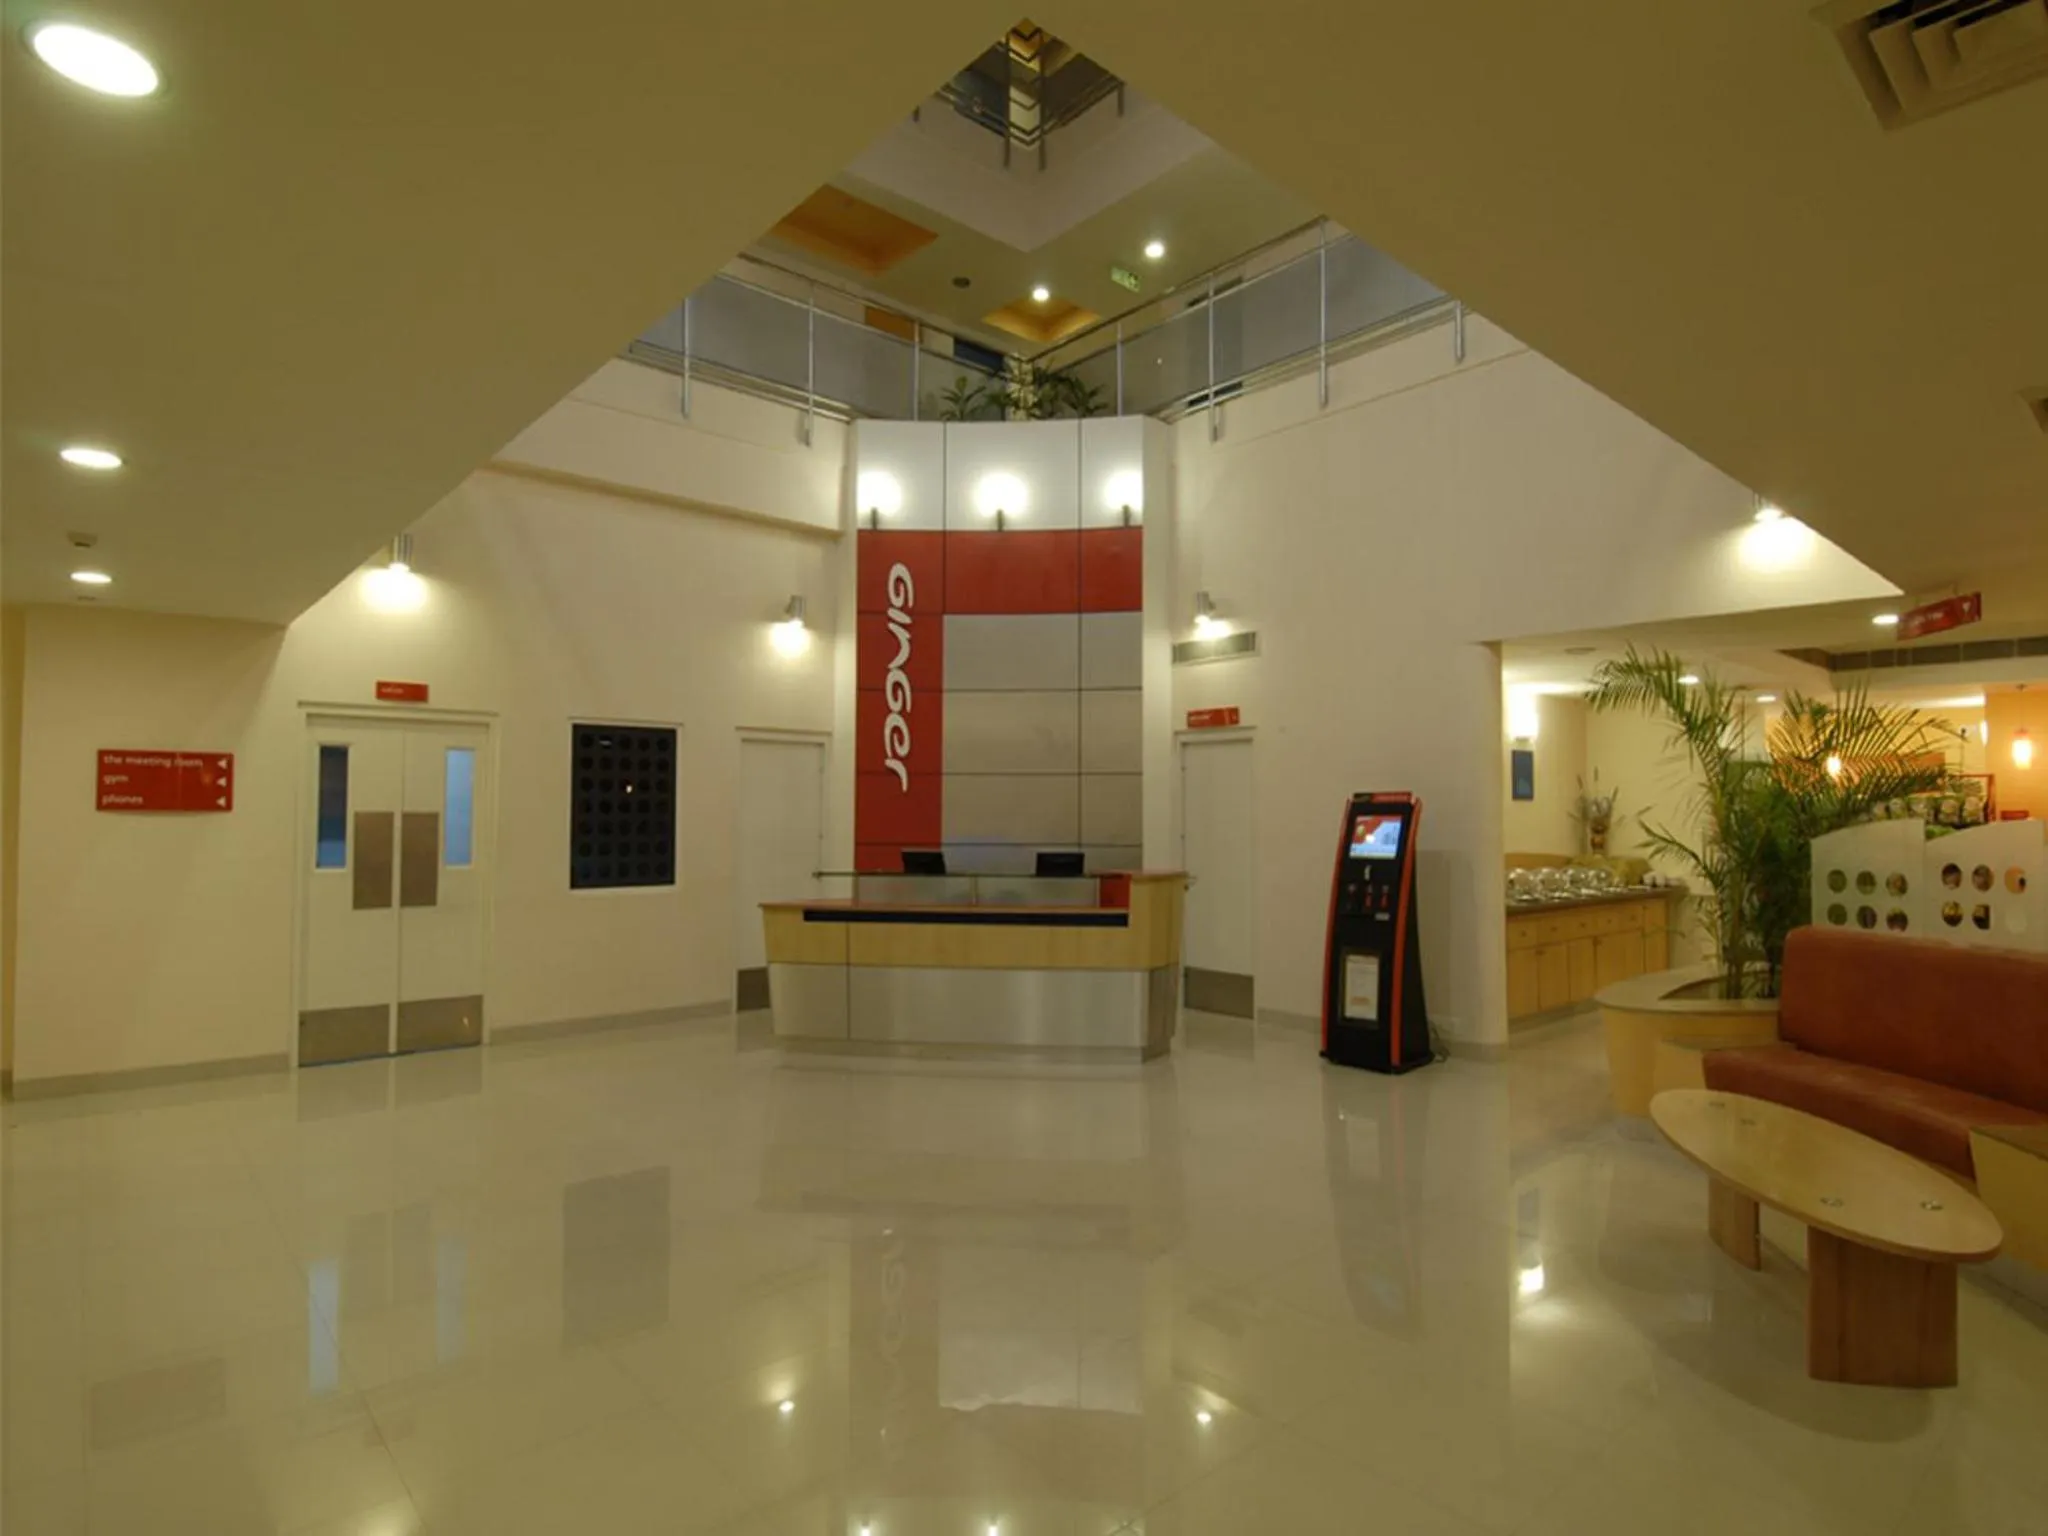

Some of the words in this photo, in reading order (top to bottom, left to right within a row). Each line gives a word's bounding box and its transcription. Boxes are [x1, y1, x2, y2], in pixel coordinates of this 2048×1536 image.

[103, 755, 123, 764] the
[125, 756, 172, 768] meeting
[174, 758, 204, 767] room
[103, 774, 129, 785] gym
[102, 795, 143, 806] phones
